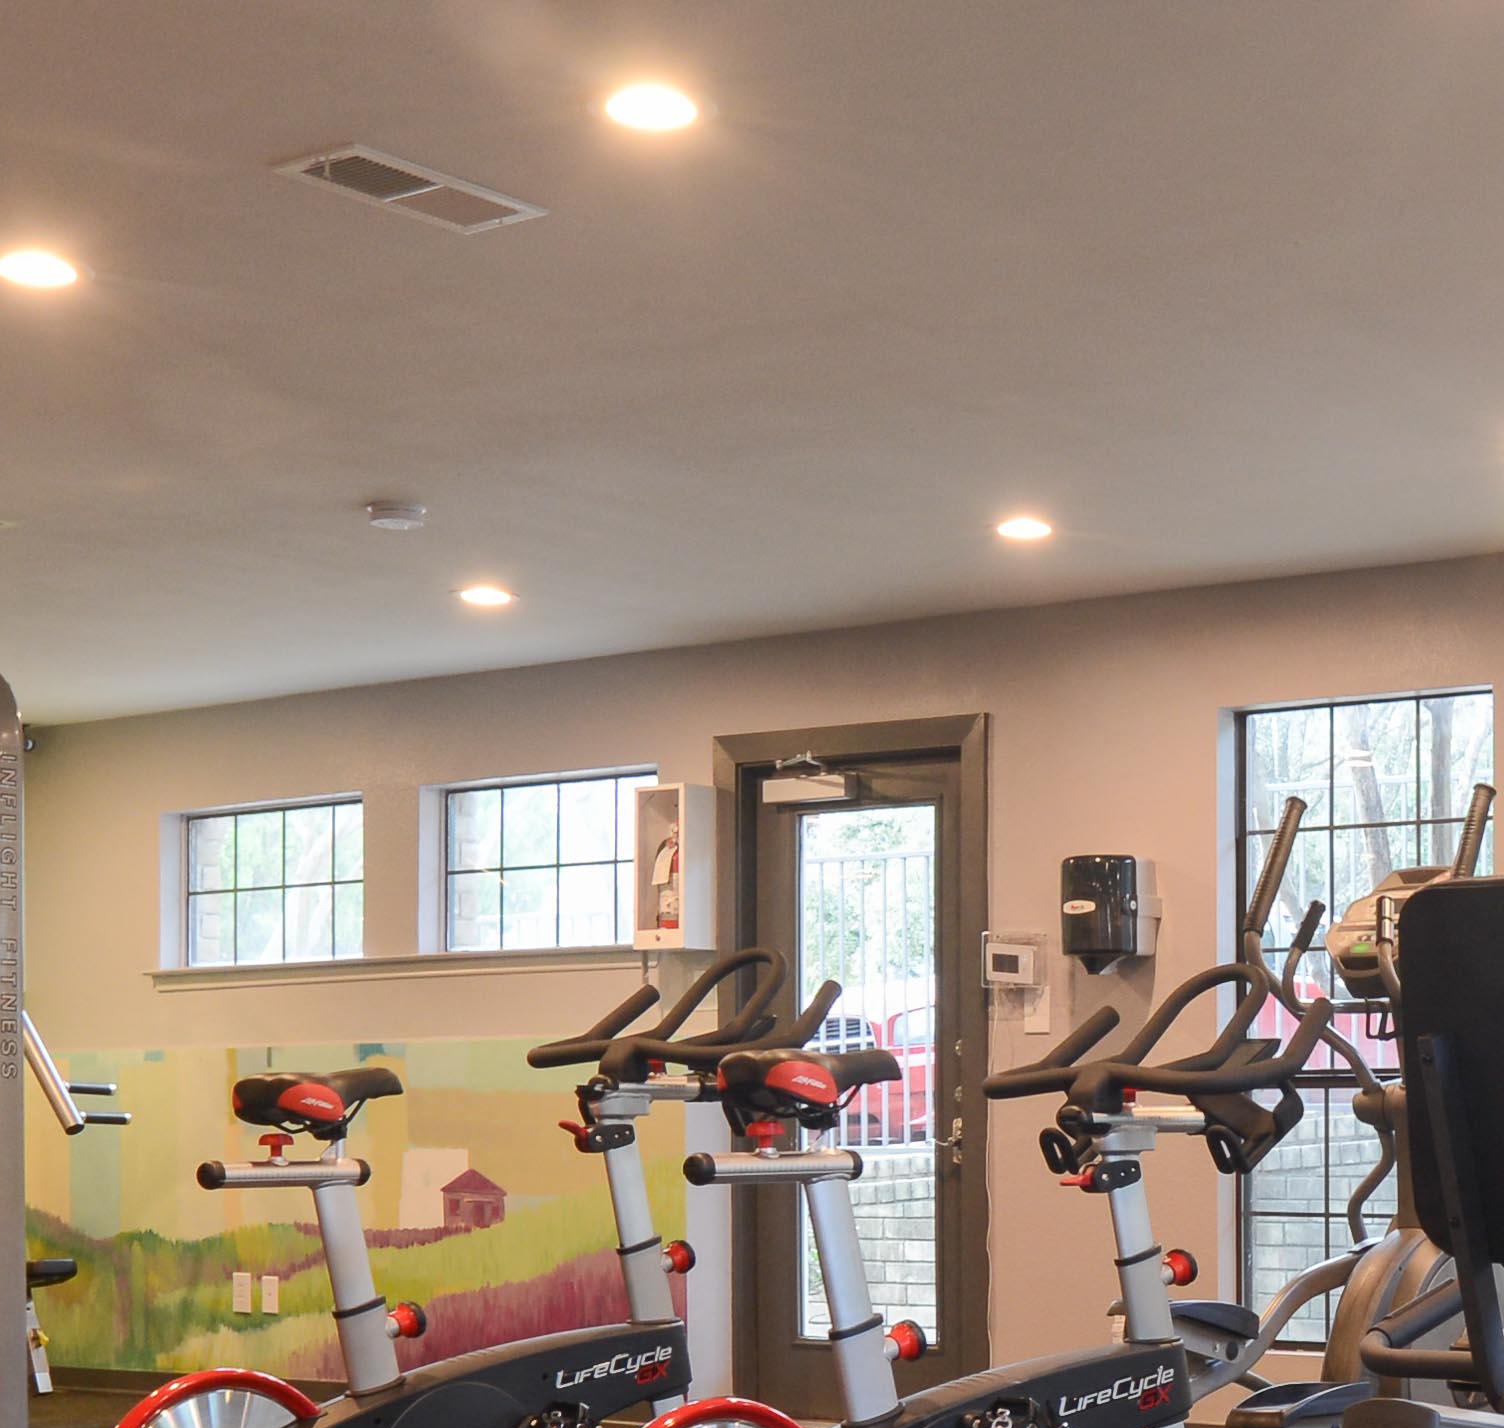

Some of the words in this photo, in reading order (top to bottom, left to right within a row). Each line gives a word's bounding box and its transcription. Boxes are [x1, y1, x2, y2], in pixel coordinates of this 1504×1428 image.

[0, 753, 18, 911] INFLIGHT
[0, 938, 18, 1079] FITNESS
[635, 1359, 671, 1385] GX
[1138, 1382, 1174, 1412] GX
